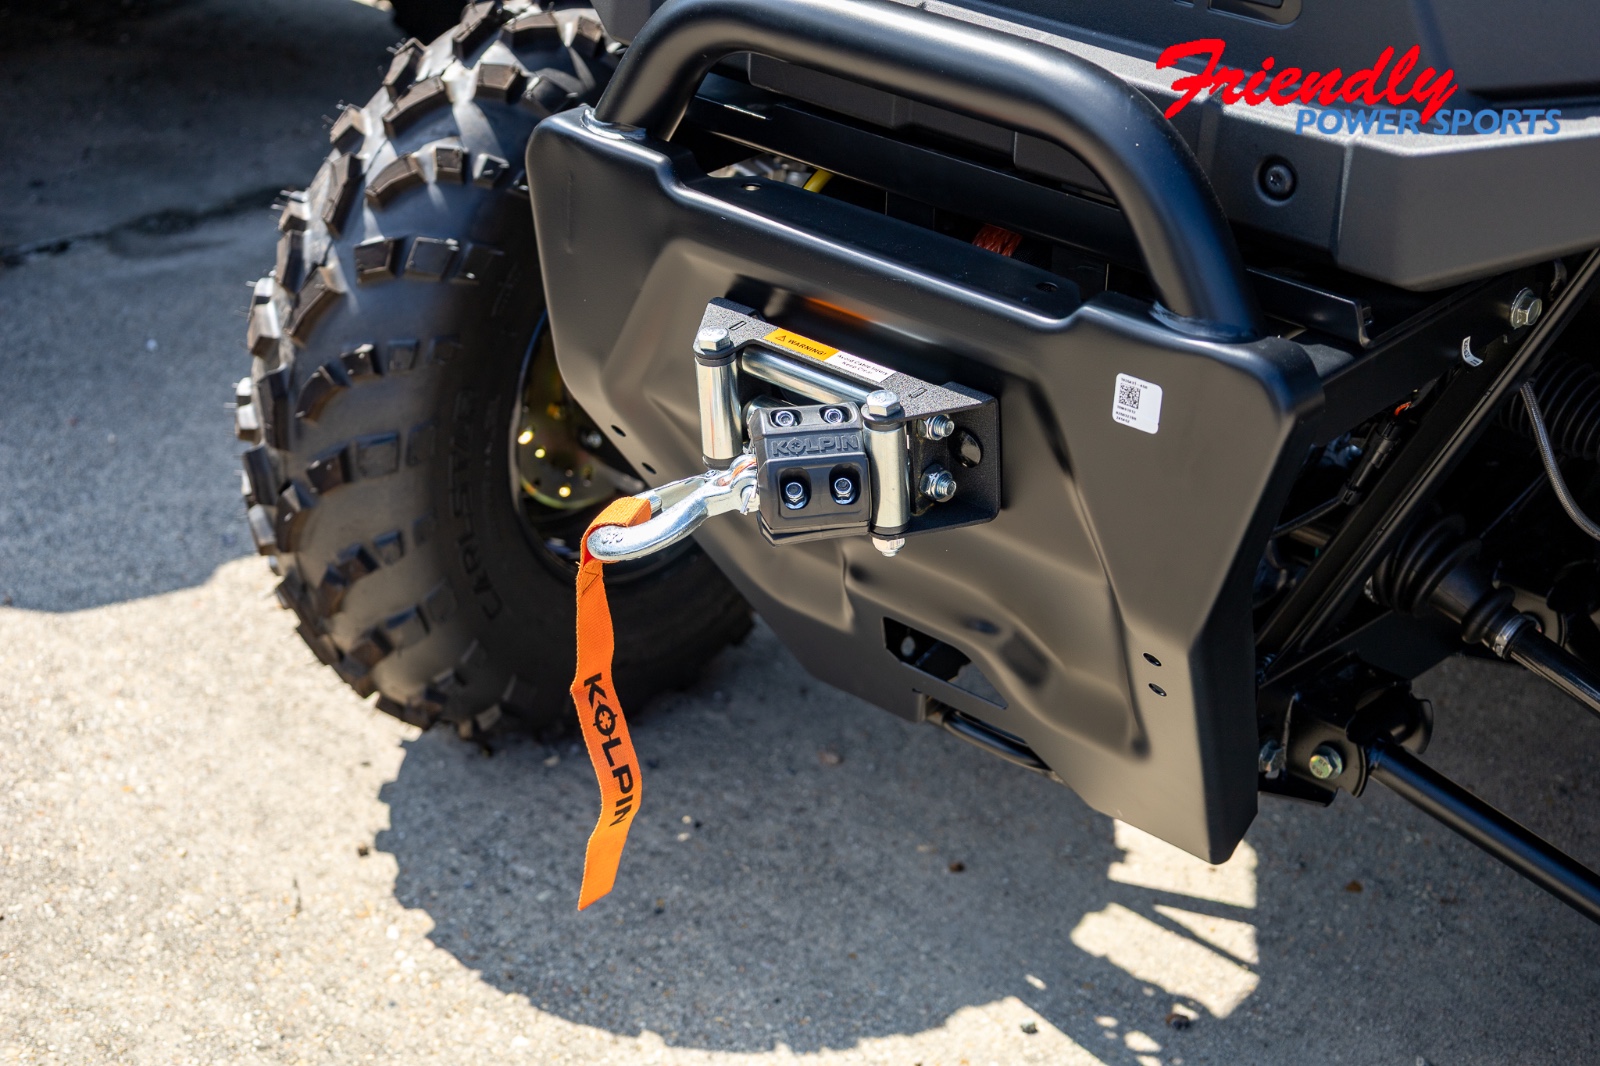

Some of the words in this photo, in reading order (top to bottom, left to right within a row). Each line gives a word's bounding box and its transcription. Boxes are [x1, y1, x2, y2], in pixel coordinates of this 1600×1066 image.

[788, 339, 827, 356] WARNING!
[771, 434, 860, 457] KOLPIN
[584, 672, 634, 827] KOLPIN
